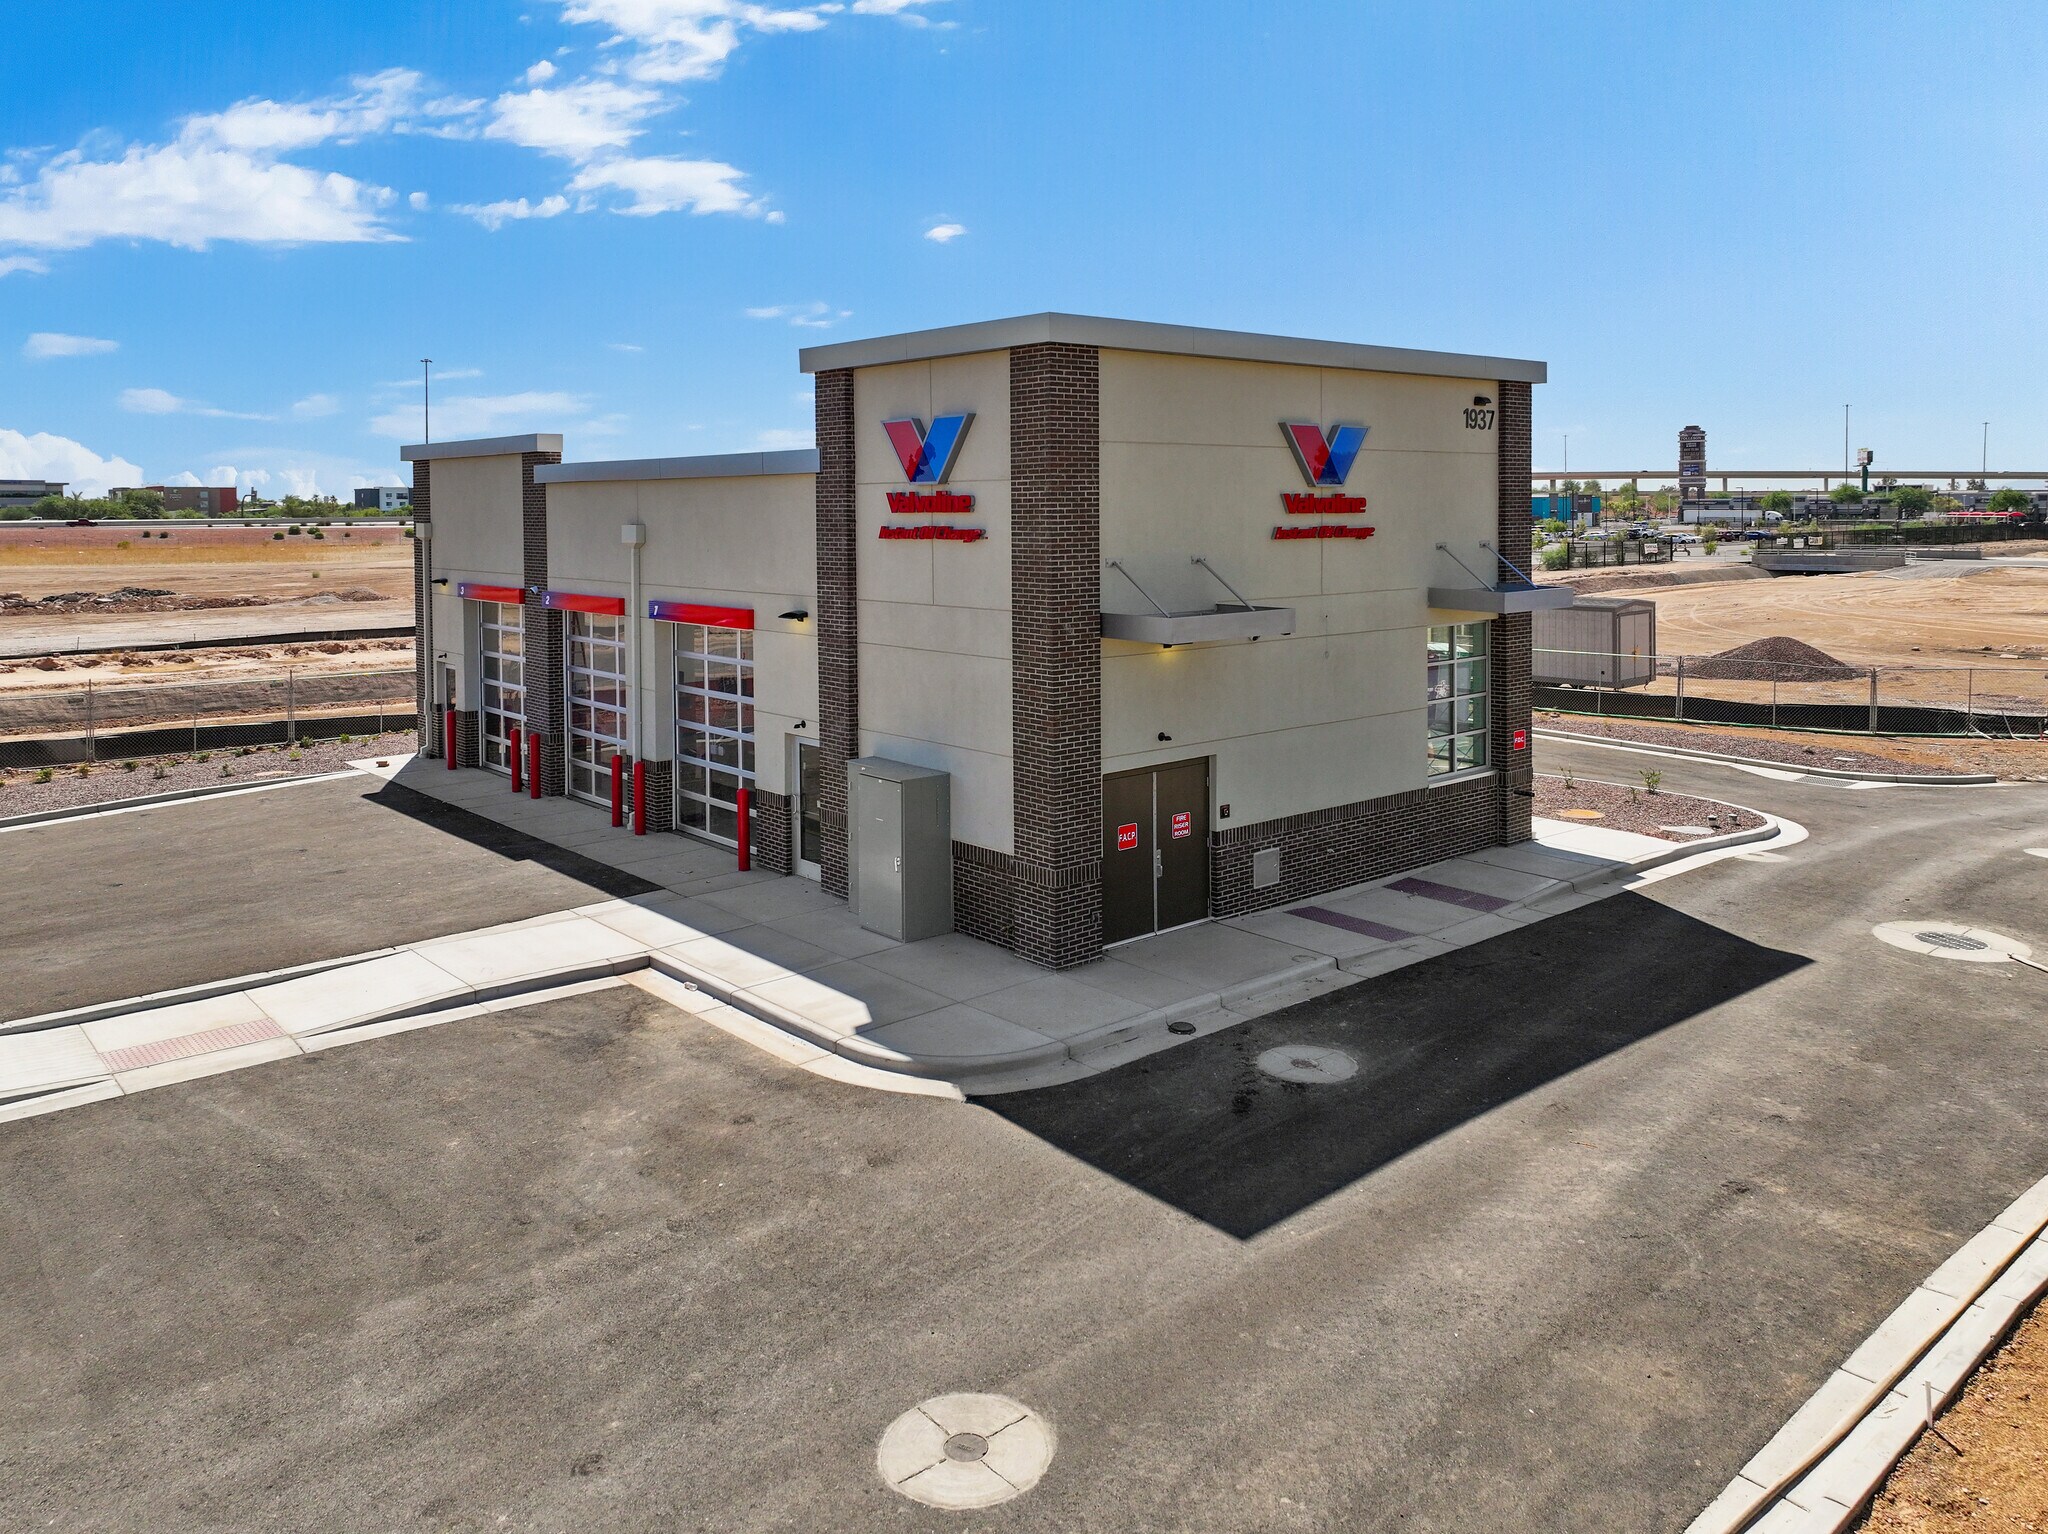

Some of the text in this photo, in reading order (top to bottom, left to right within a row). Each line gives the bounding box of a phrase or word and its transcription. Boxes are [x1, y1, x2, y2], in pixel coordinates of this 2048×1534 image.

[1463, 408, 1495, 430] 1937
[886, 491, 973, 513] Valvoline
[1282, 493, 1367, 514] Valvoline
[879, 526, 983, 543] Instant Oil Change
[1274, 526, 1376, 540] Instant Oil Change
[1173, 821, 1189, 830] RISER
[1175, 814, 1187, 822] FIRE
[1174, 828, 1189, 837] ROOM
